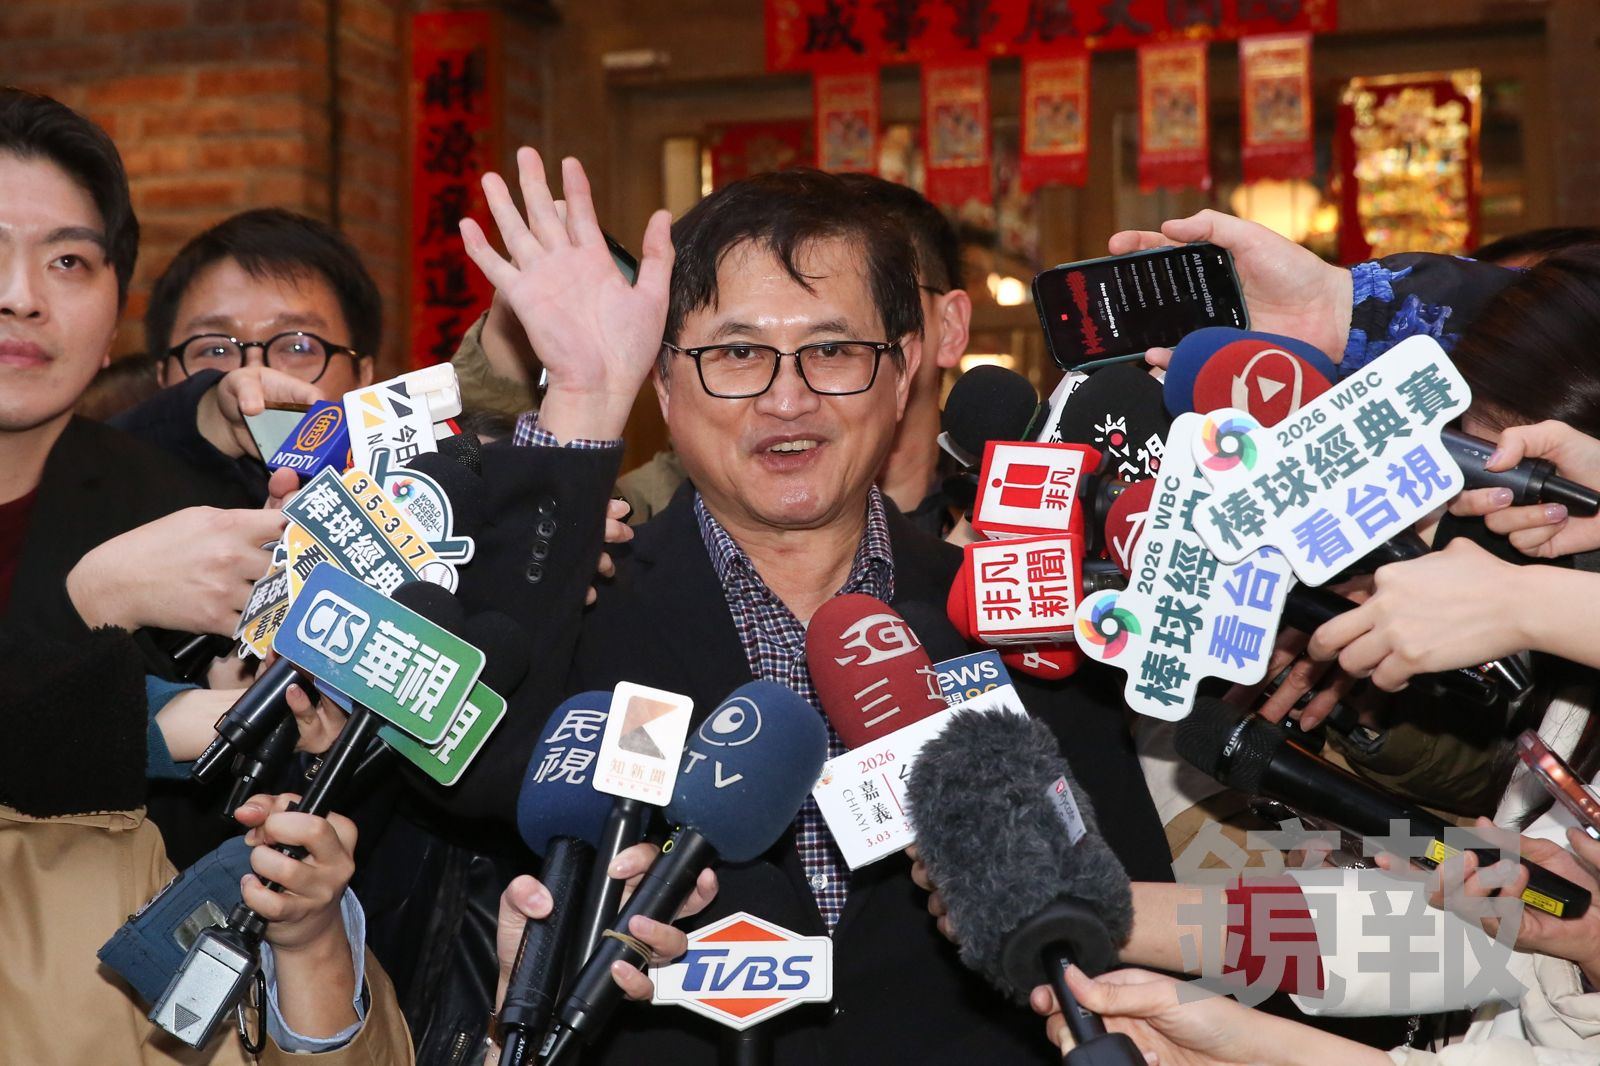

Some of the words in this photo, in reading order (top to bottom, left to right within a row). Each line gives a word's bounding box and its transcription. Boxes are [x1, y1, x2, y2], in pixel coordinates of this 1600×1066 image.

[1192, 252, 1202, 266] All
[1099, 282, 1108, 297] New
[1194, 266, 1216, 318] Recordings
[1103, 297, 1116, 329] Recording
[1277, 408, 1327, 449] 2026
[1329, 371, 1383, 411] WBC
[271, 451, 319, 469] NTDTV
[1207, 363, 1460, 551] 棒球經典賽
[419, 492, 442, 519] WORLD
[1044, 467, 1076, 511] 非凡
[1291, 444, 1453, 568] 看台視
[408, 503, 435, 532] CLASSIC
[413, 497, 444, 534] BASEBALL
[1138, 540, 1163, 595] 2026
[1153, 475, 1181, 530] WBC
[981, 553, 1021, 621] 非凡
[1027, 548, 1070, 618] 新聞
[304, 598, 365, 654] CTS
[1208, 546, 1282, 669] 看台
[352, 619, 461, 723] 華視
[937, 661, 999, 692] ews
[533, 709, 608, 785] 民視
[683, 748, 744, 789] TV
[858, 749, 896, 774] 2026
[608, 757, 667, 785] 知新聞
[842, 789, 870, 832] CHIAYI
[859, 779, 893, 824] 嘉義
[866, 830, 891, 848] 3.03
[673, 949, 813, 992] TVBS
